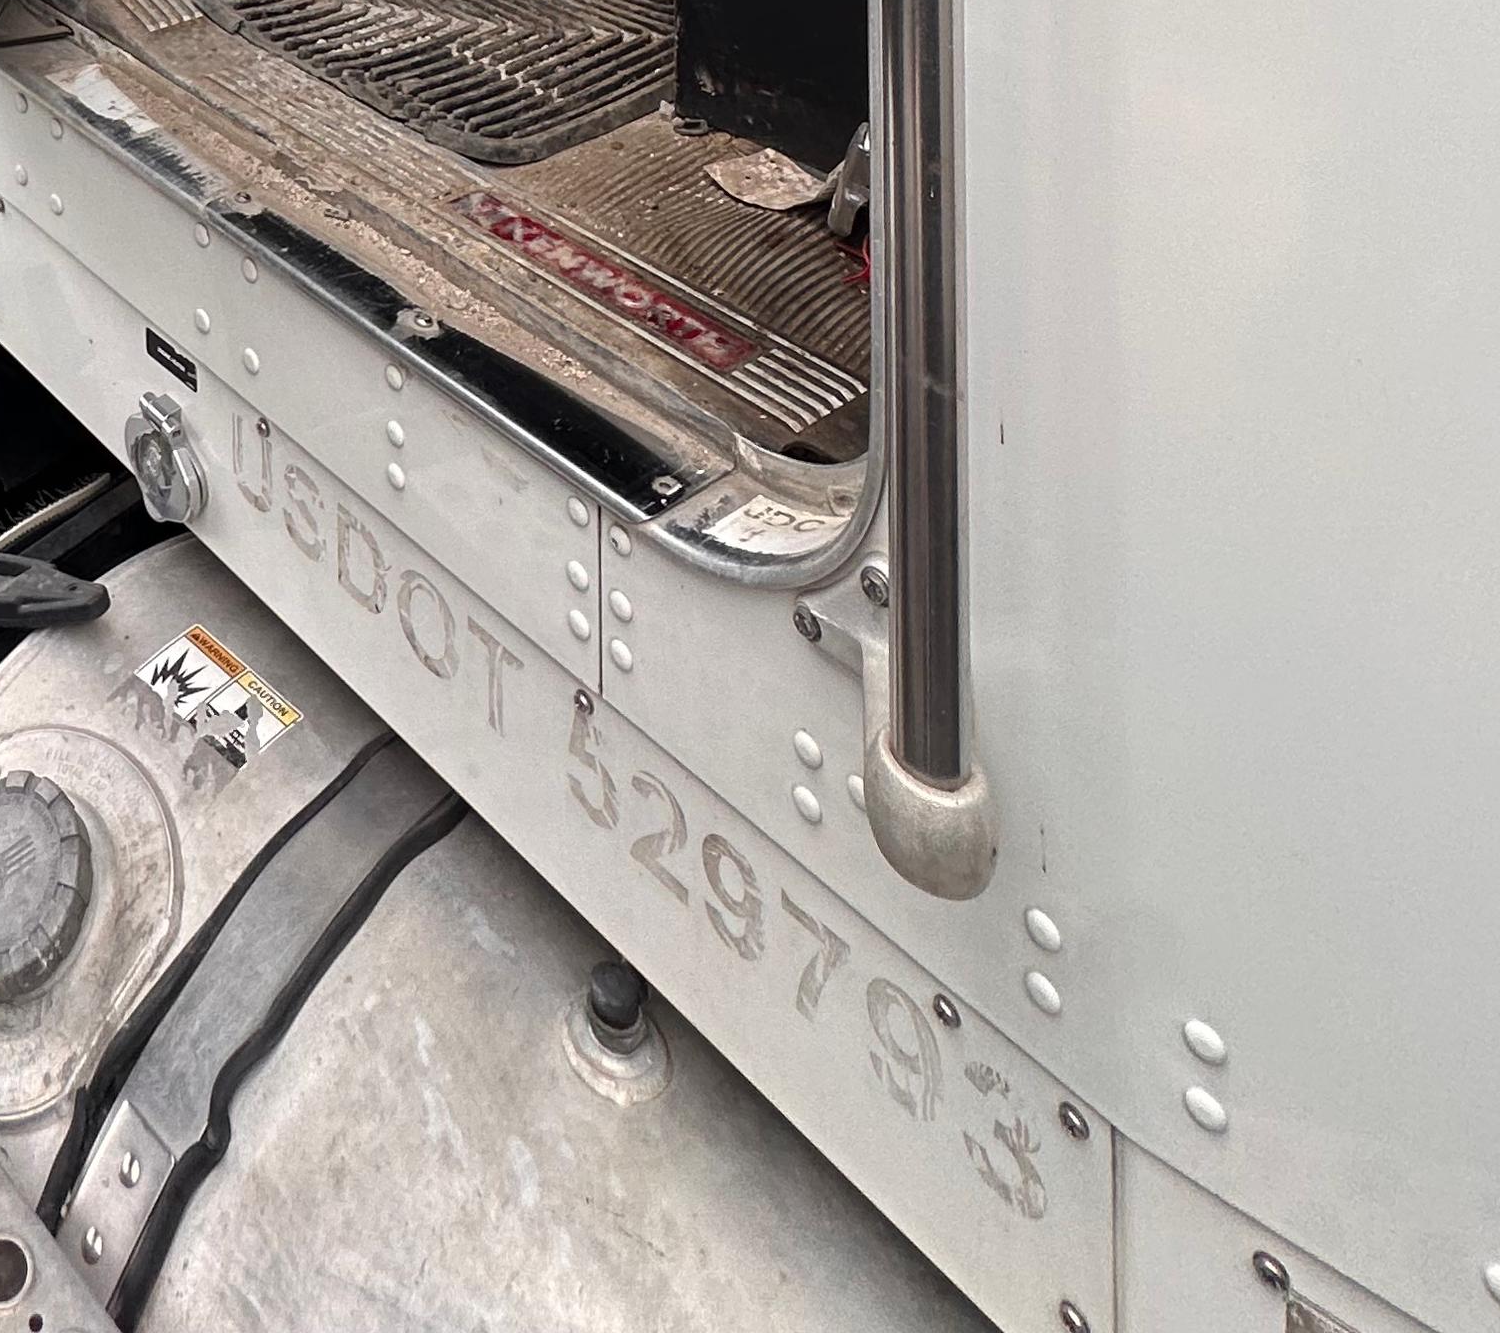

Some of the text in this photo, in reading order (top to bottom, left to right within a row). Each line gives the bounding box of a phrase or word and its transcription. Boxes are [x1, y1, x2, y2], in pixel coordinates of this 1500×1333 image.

[230, 414, 524, 737] USDOT
[196, 632, 241, 674] WARNING
[247, 680, 290, 717] CAUTION
